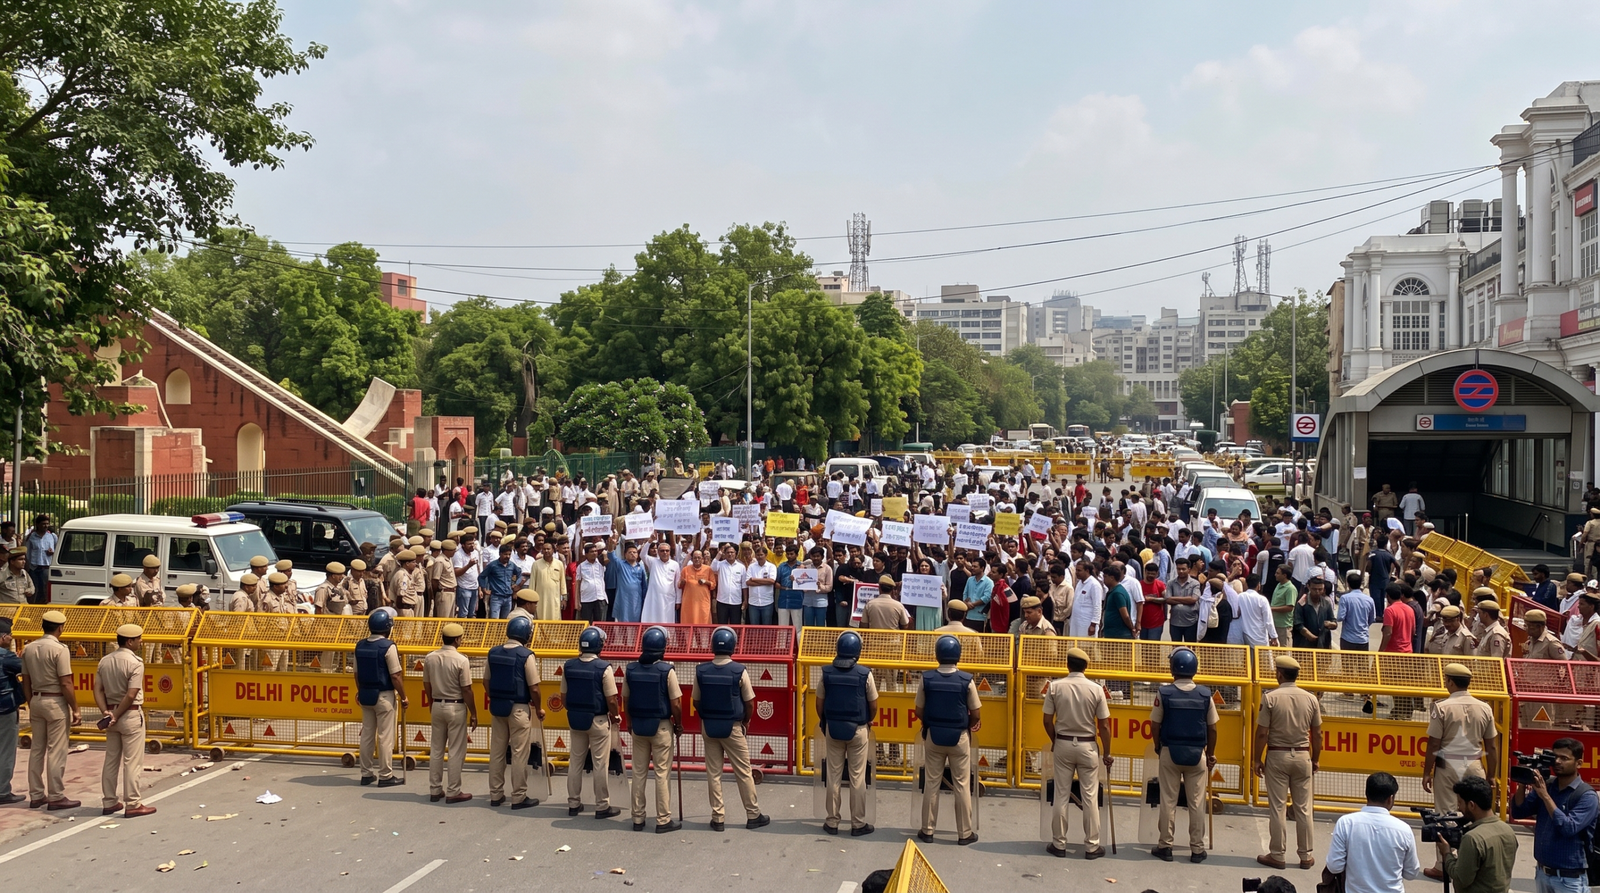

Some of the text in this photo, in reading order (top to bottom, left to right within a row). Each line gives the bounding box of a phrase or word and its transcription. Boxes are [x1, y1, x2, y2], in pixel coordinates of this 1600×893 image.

[235, 682, 350, 705] DELHI POLICE
[1368, 733, 1429, 757] POLIC
